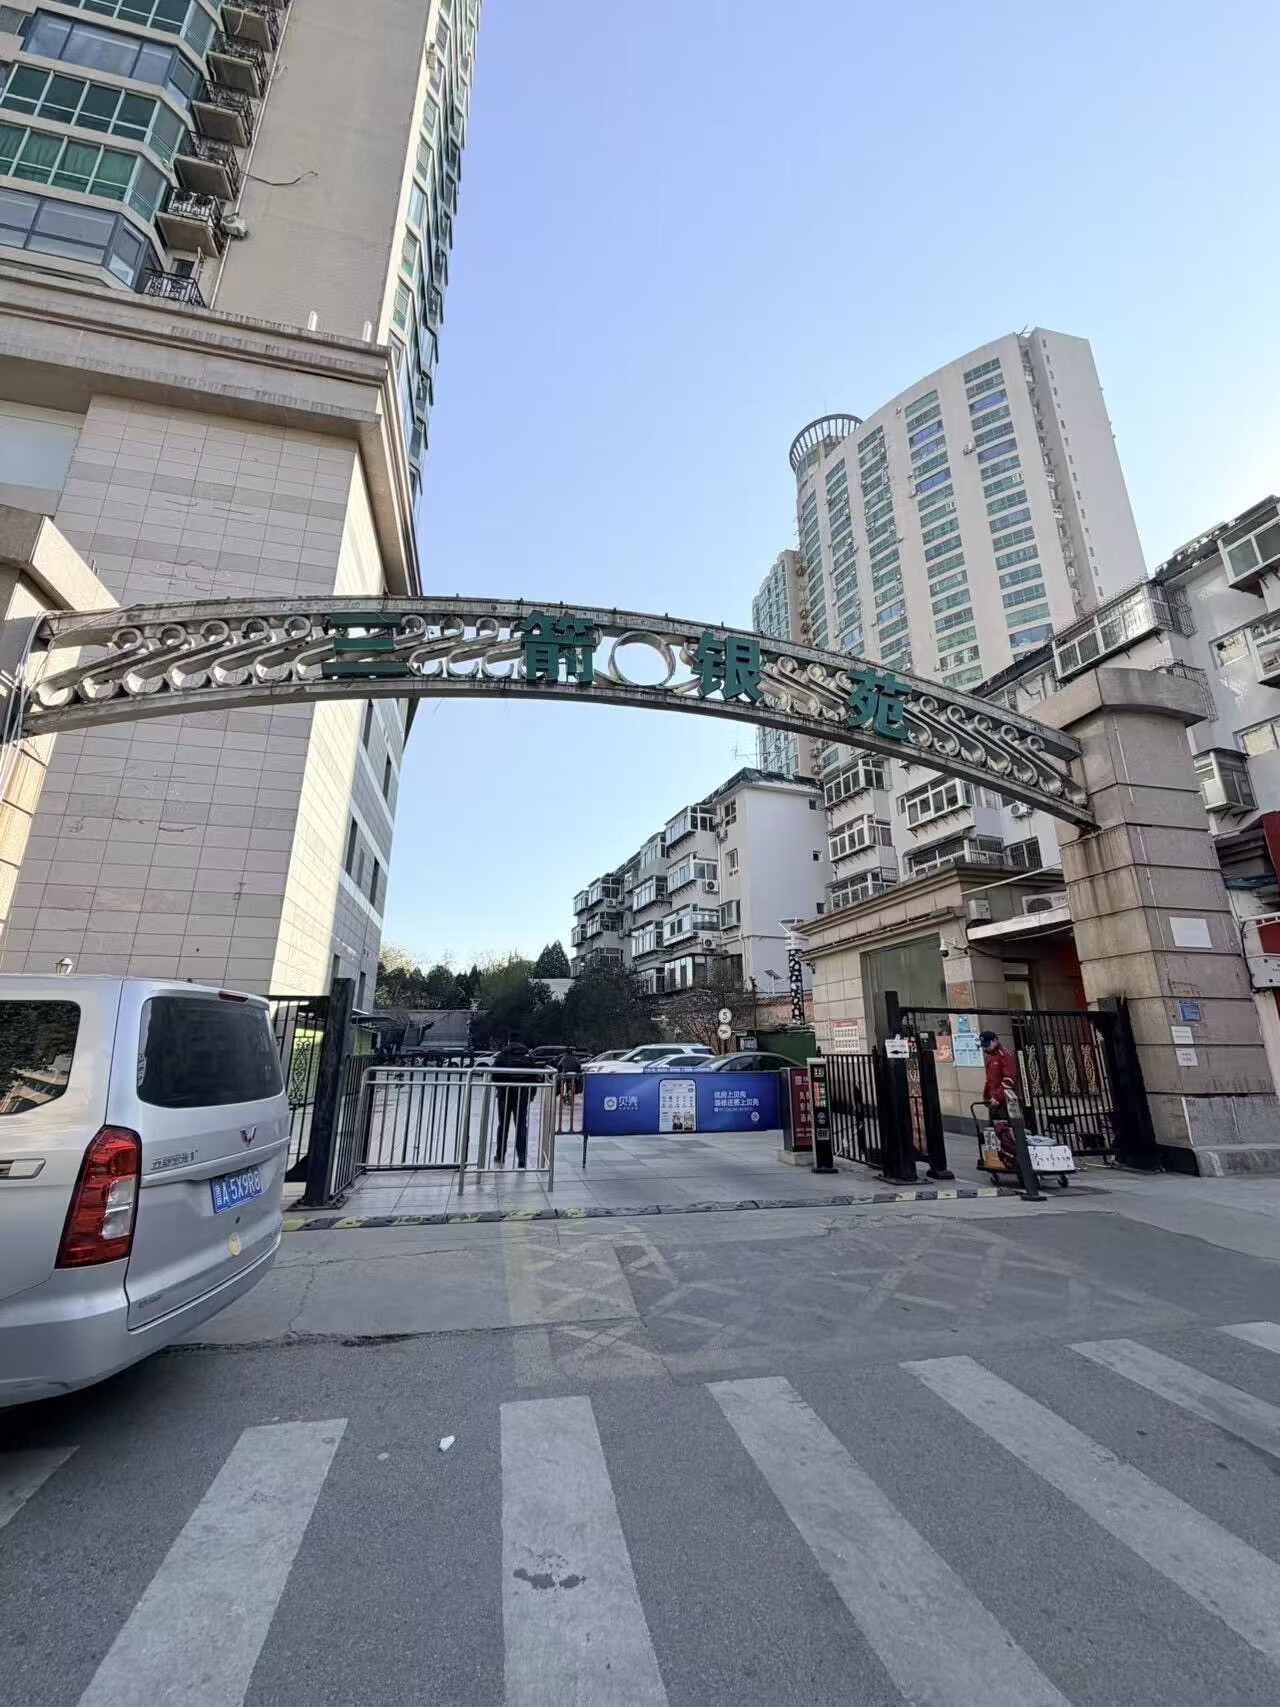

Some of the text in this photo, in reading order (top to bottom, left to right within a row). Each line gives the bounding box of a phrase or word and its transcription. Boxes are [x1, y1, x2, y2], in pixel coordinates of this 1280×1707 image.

[321, 609, 913, 743] 三箭银苑
[722, 1011, 728, 1021] 5
[618, 1096, 638, 1107] 贝壳
